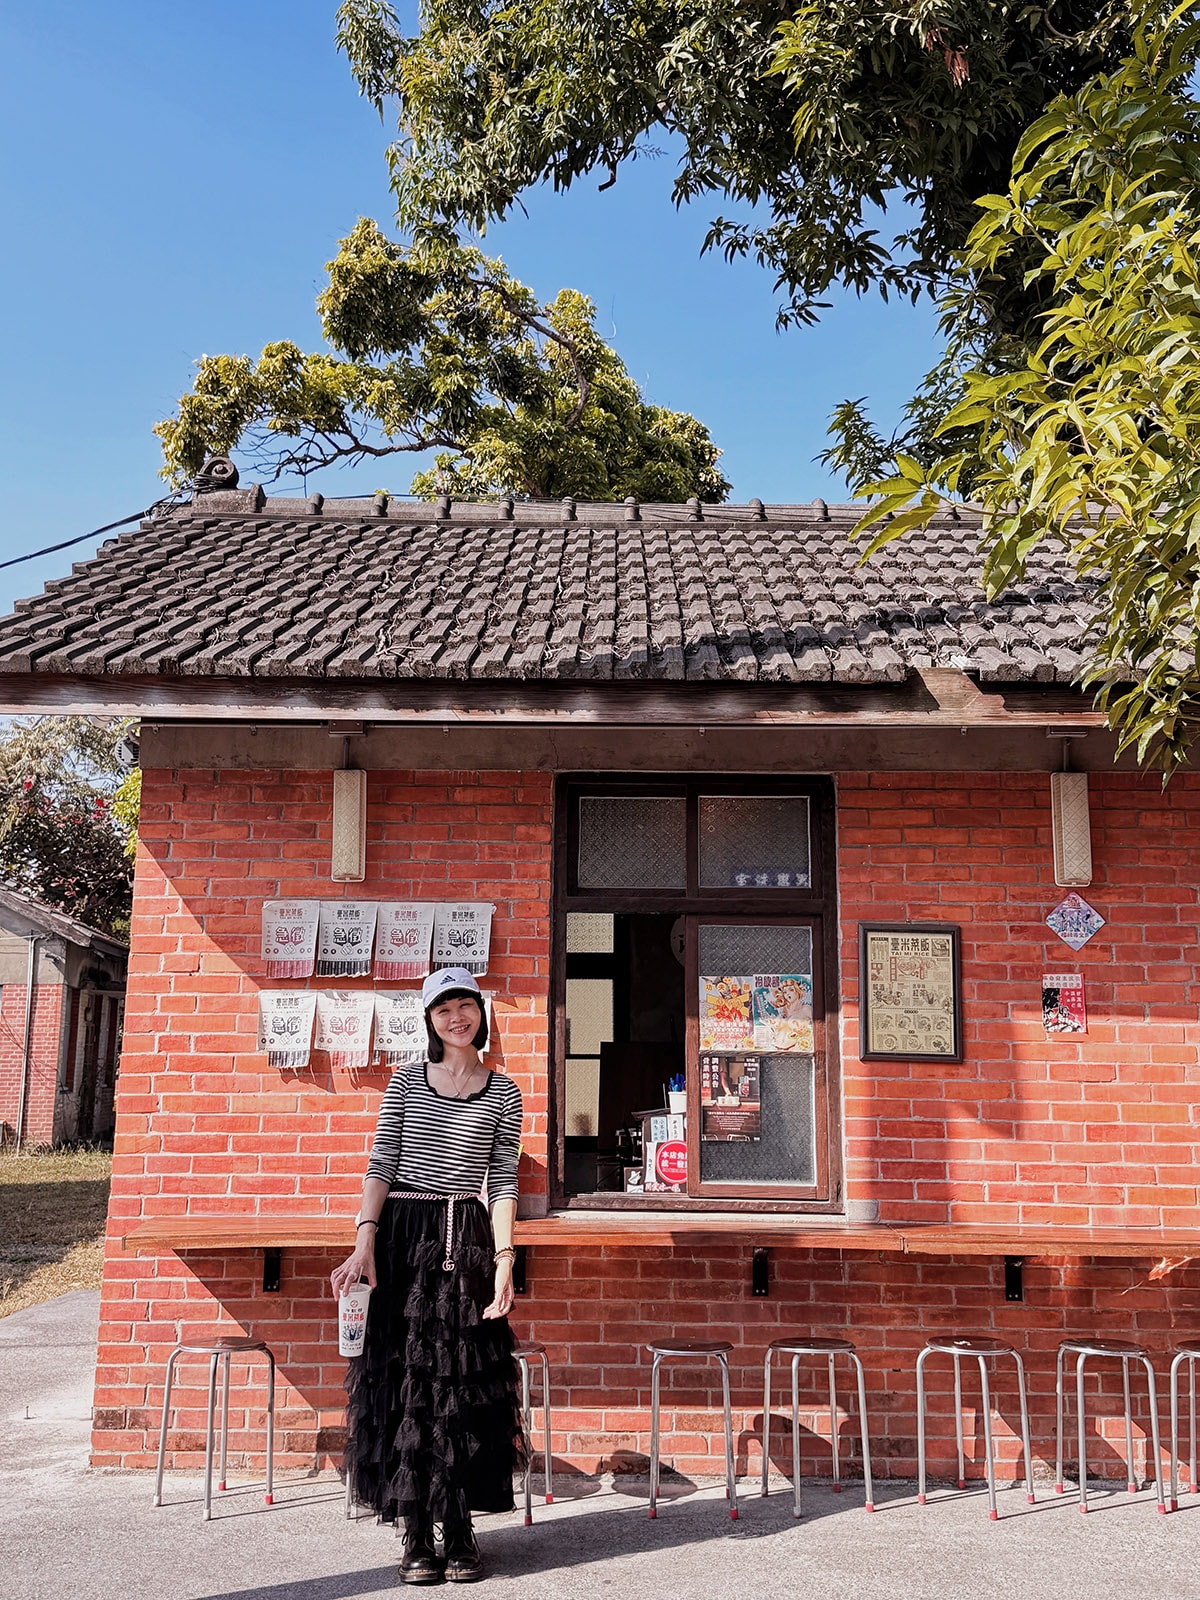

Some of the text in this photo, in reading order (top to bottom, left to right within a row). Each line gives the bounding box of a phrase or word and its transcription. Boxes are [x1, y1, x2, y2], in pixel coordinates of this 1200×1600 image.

[755, 976, 780, 987] 冷飲部
[702, 1057, 710, 1088] 營業時間
[711, 1057, 719, 1088] 調整公告
[661, 1151, 687, 1160] 本店免
